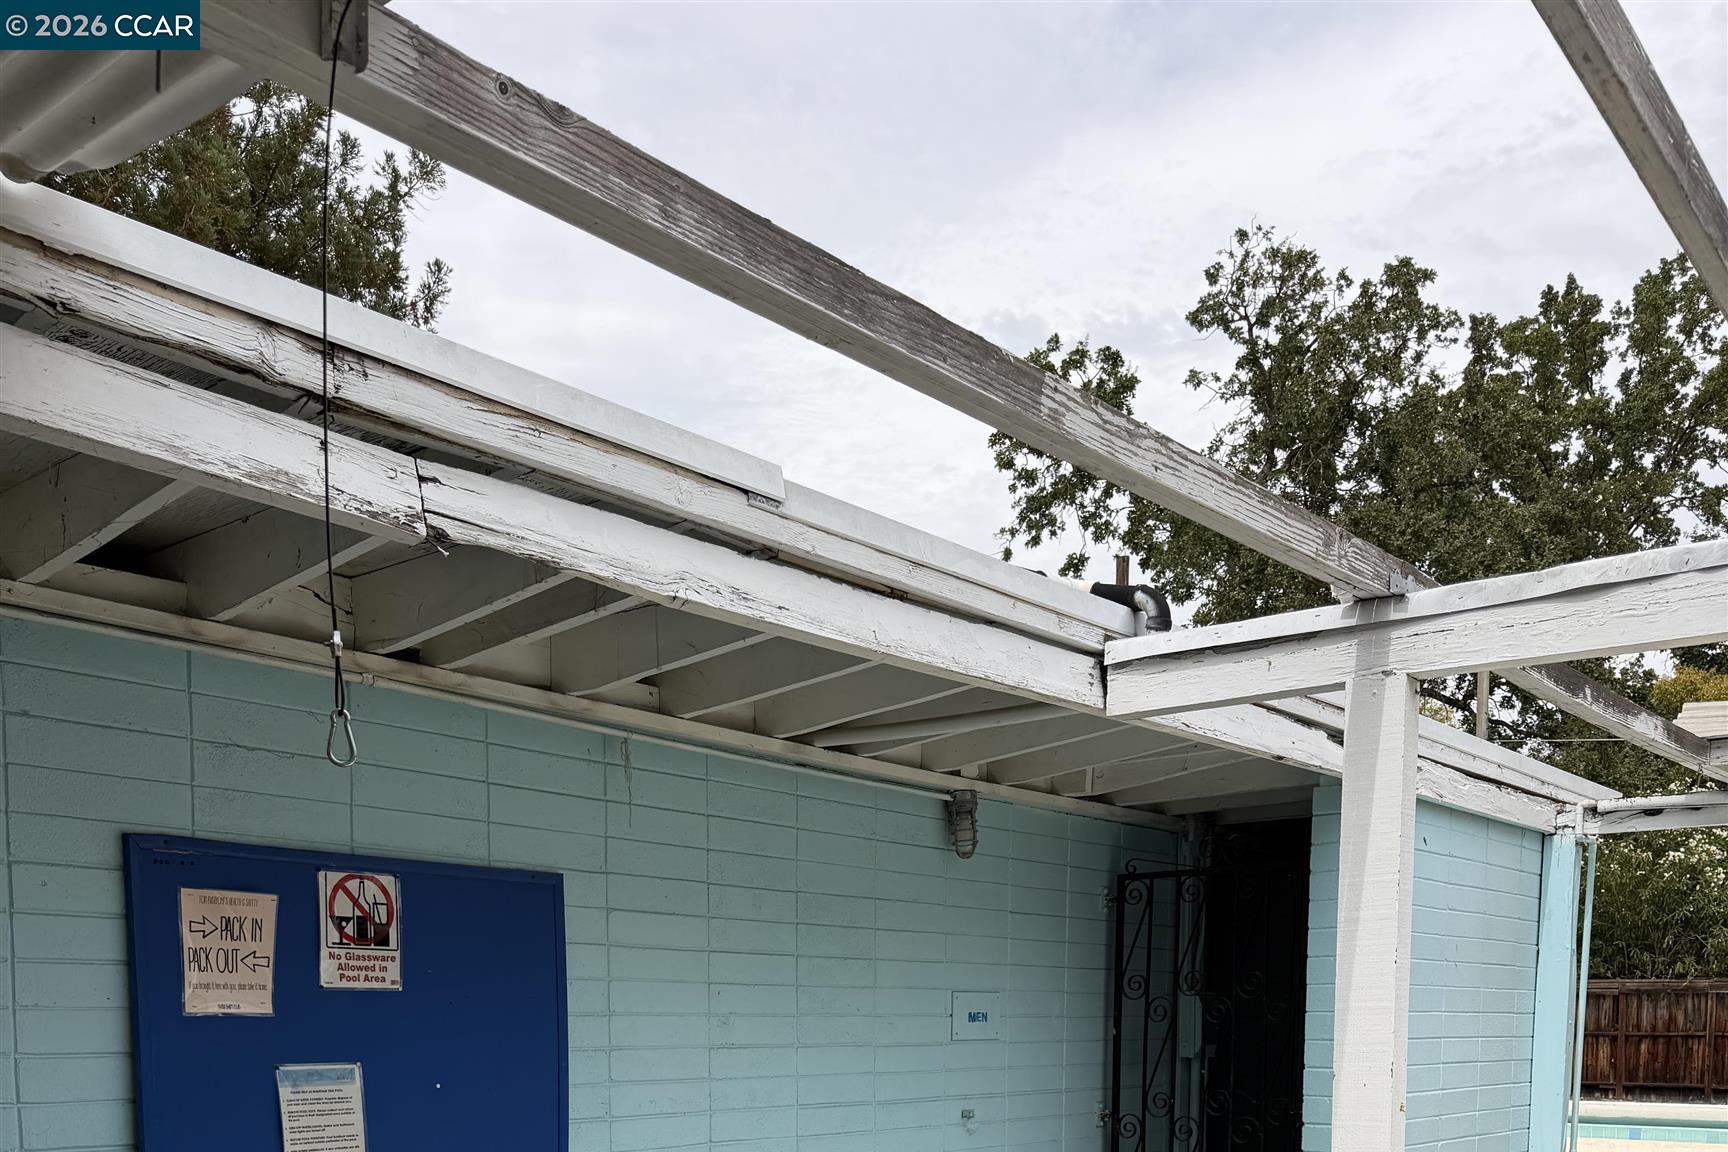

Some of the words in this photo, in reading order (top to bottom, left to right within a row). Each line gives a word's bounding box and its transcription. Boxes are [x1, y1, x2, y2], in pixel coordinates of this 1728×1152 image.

[220, 915, 248, 943] PACK
[251, 917, 264, 943] IN
[188, 946, 214, 973] PACK
[216, 947, 241, 974] OUT
[329, 951, 342, 961] No
[345, 951, 397, 963] Glassware
[337, 963, 376, 973] Allowed
[379, 963, 388, 973] in
[339, 973, 360, 983] Pool
[363, 973, 387, 983] Area
[967, 1011, 988, 1023] MEN
